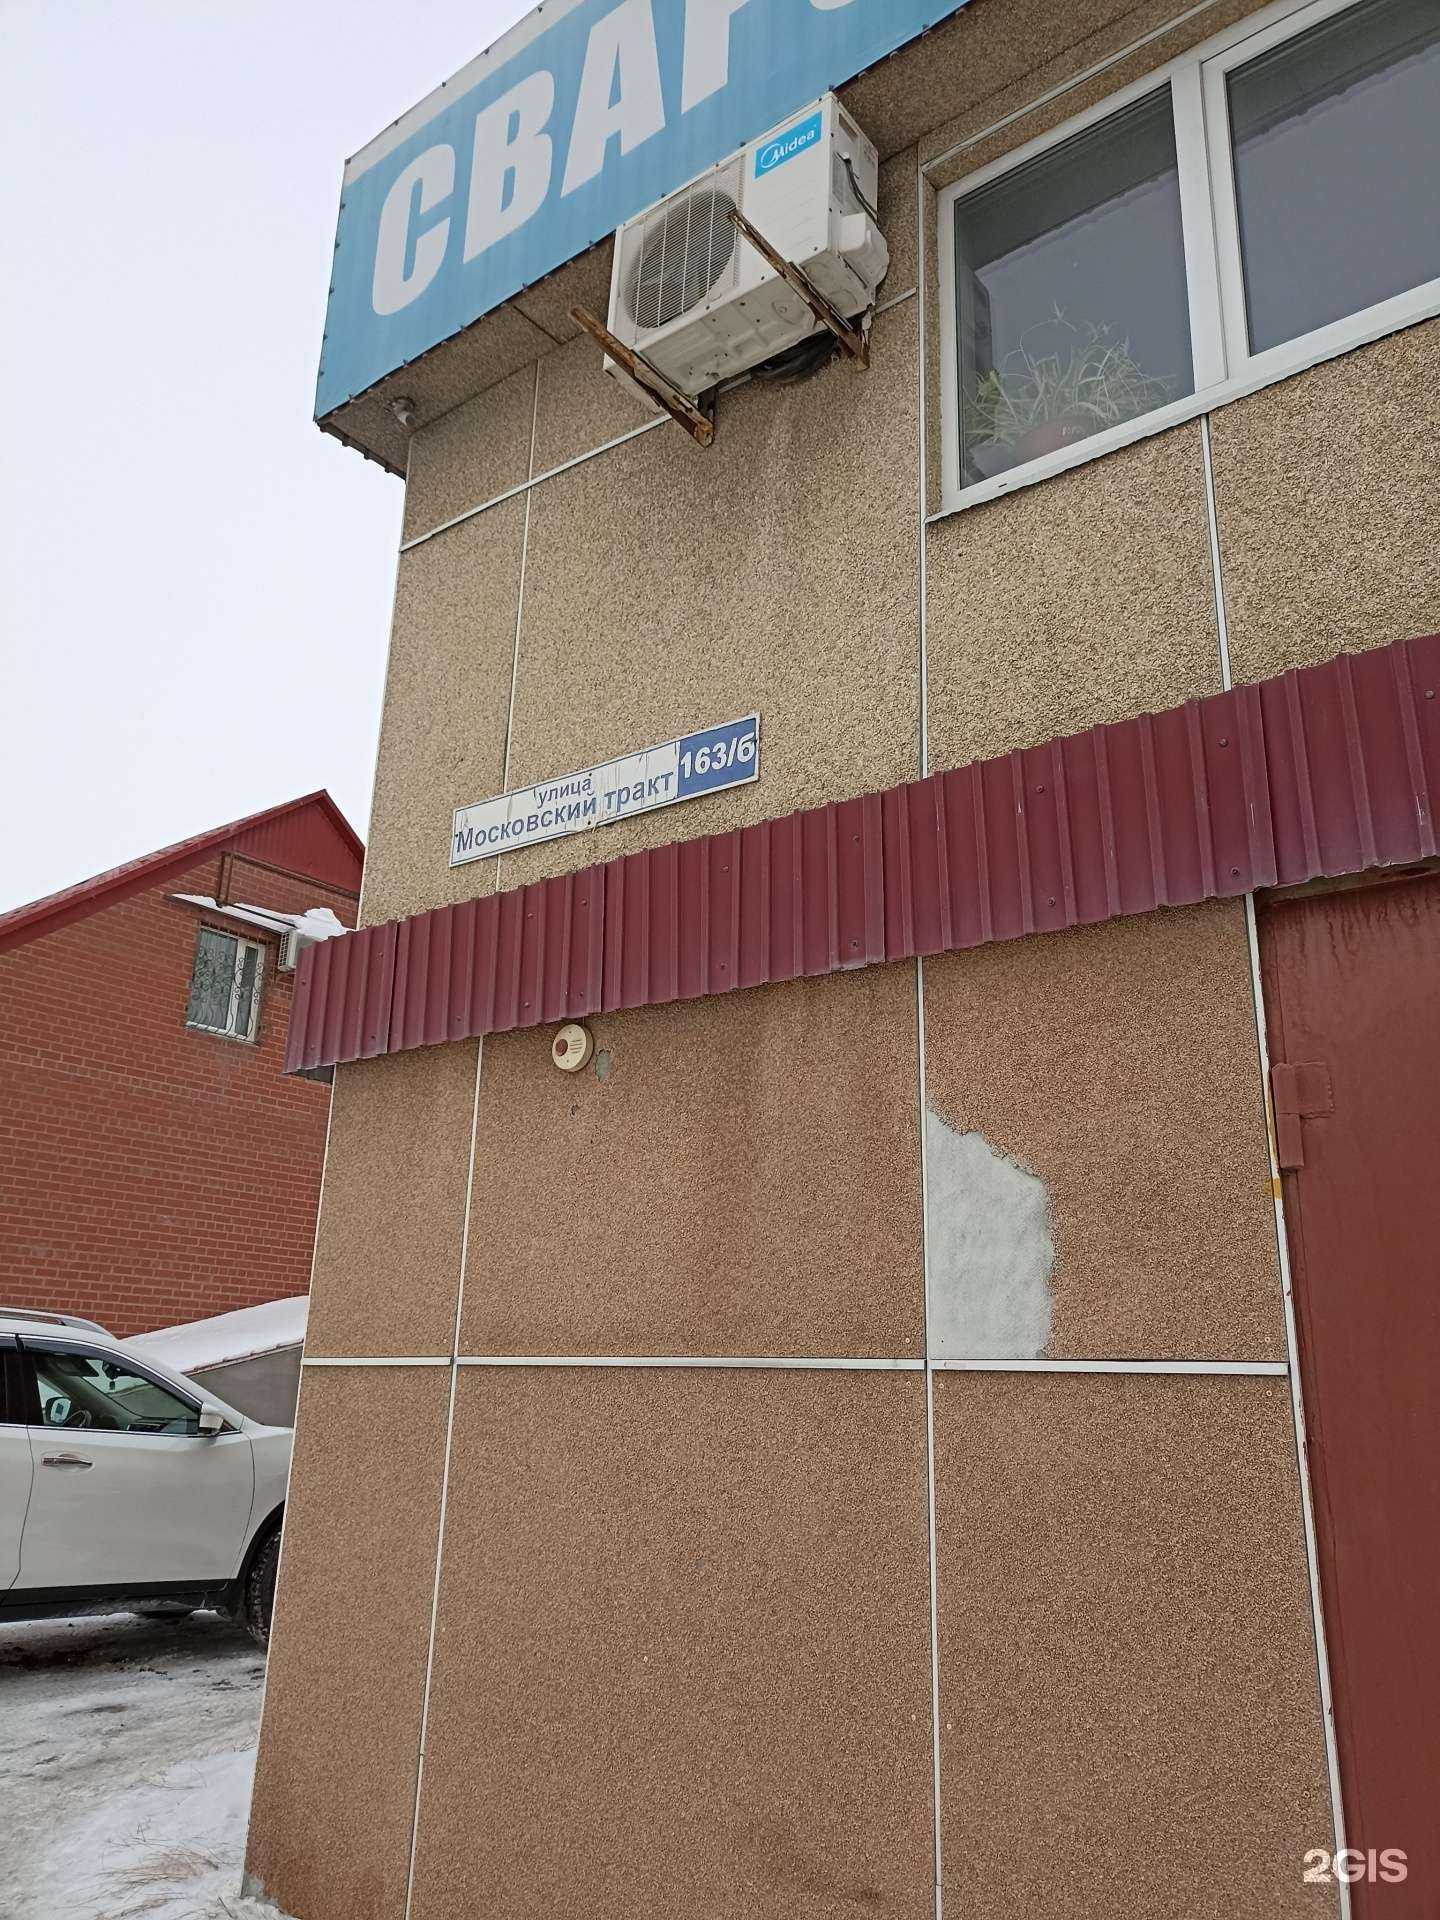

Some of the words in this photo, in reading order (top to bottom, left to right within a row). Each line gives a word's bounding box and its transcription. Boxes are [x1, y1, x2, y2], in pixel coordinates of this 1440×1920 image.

[760, 127, 816, 169] Midea
[455, 791, 597, 853] Московский
[603, 770, 675, 813] тракт
[536, 777, 593, 809] улица
